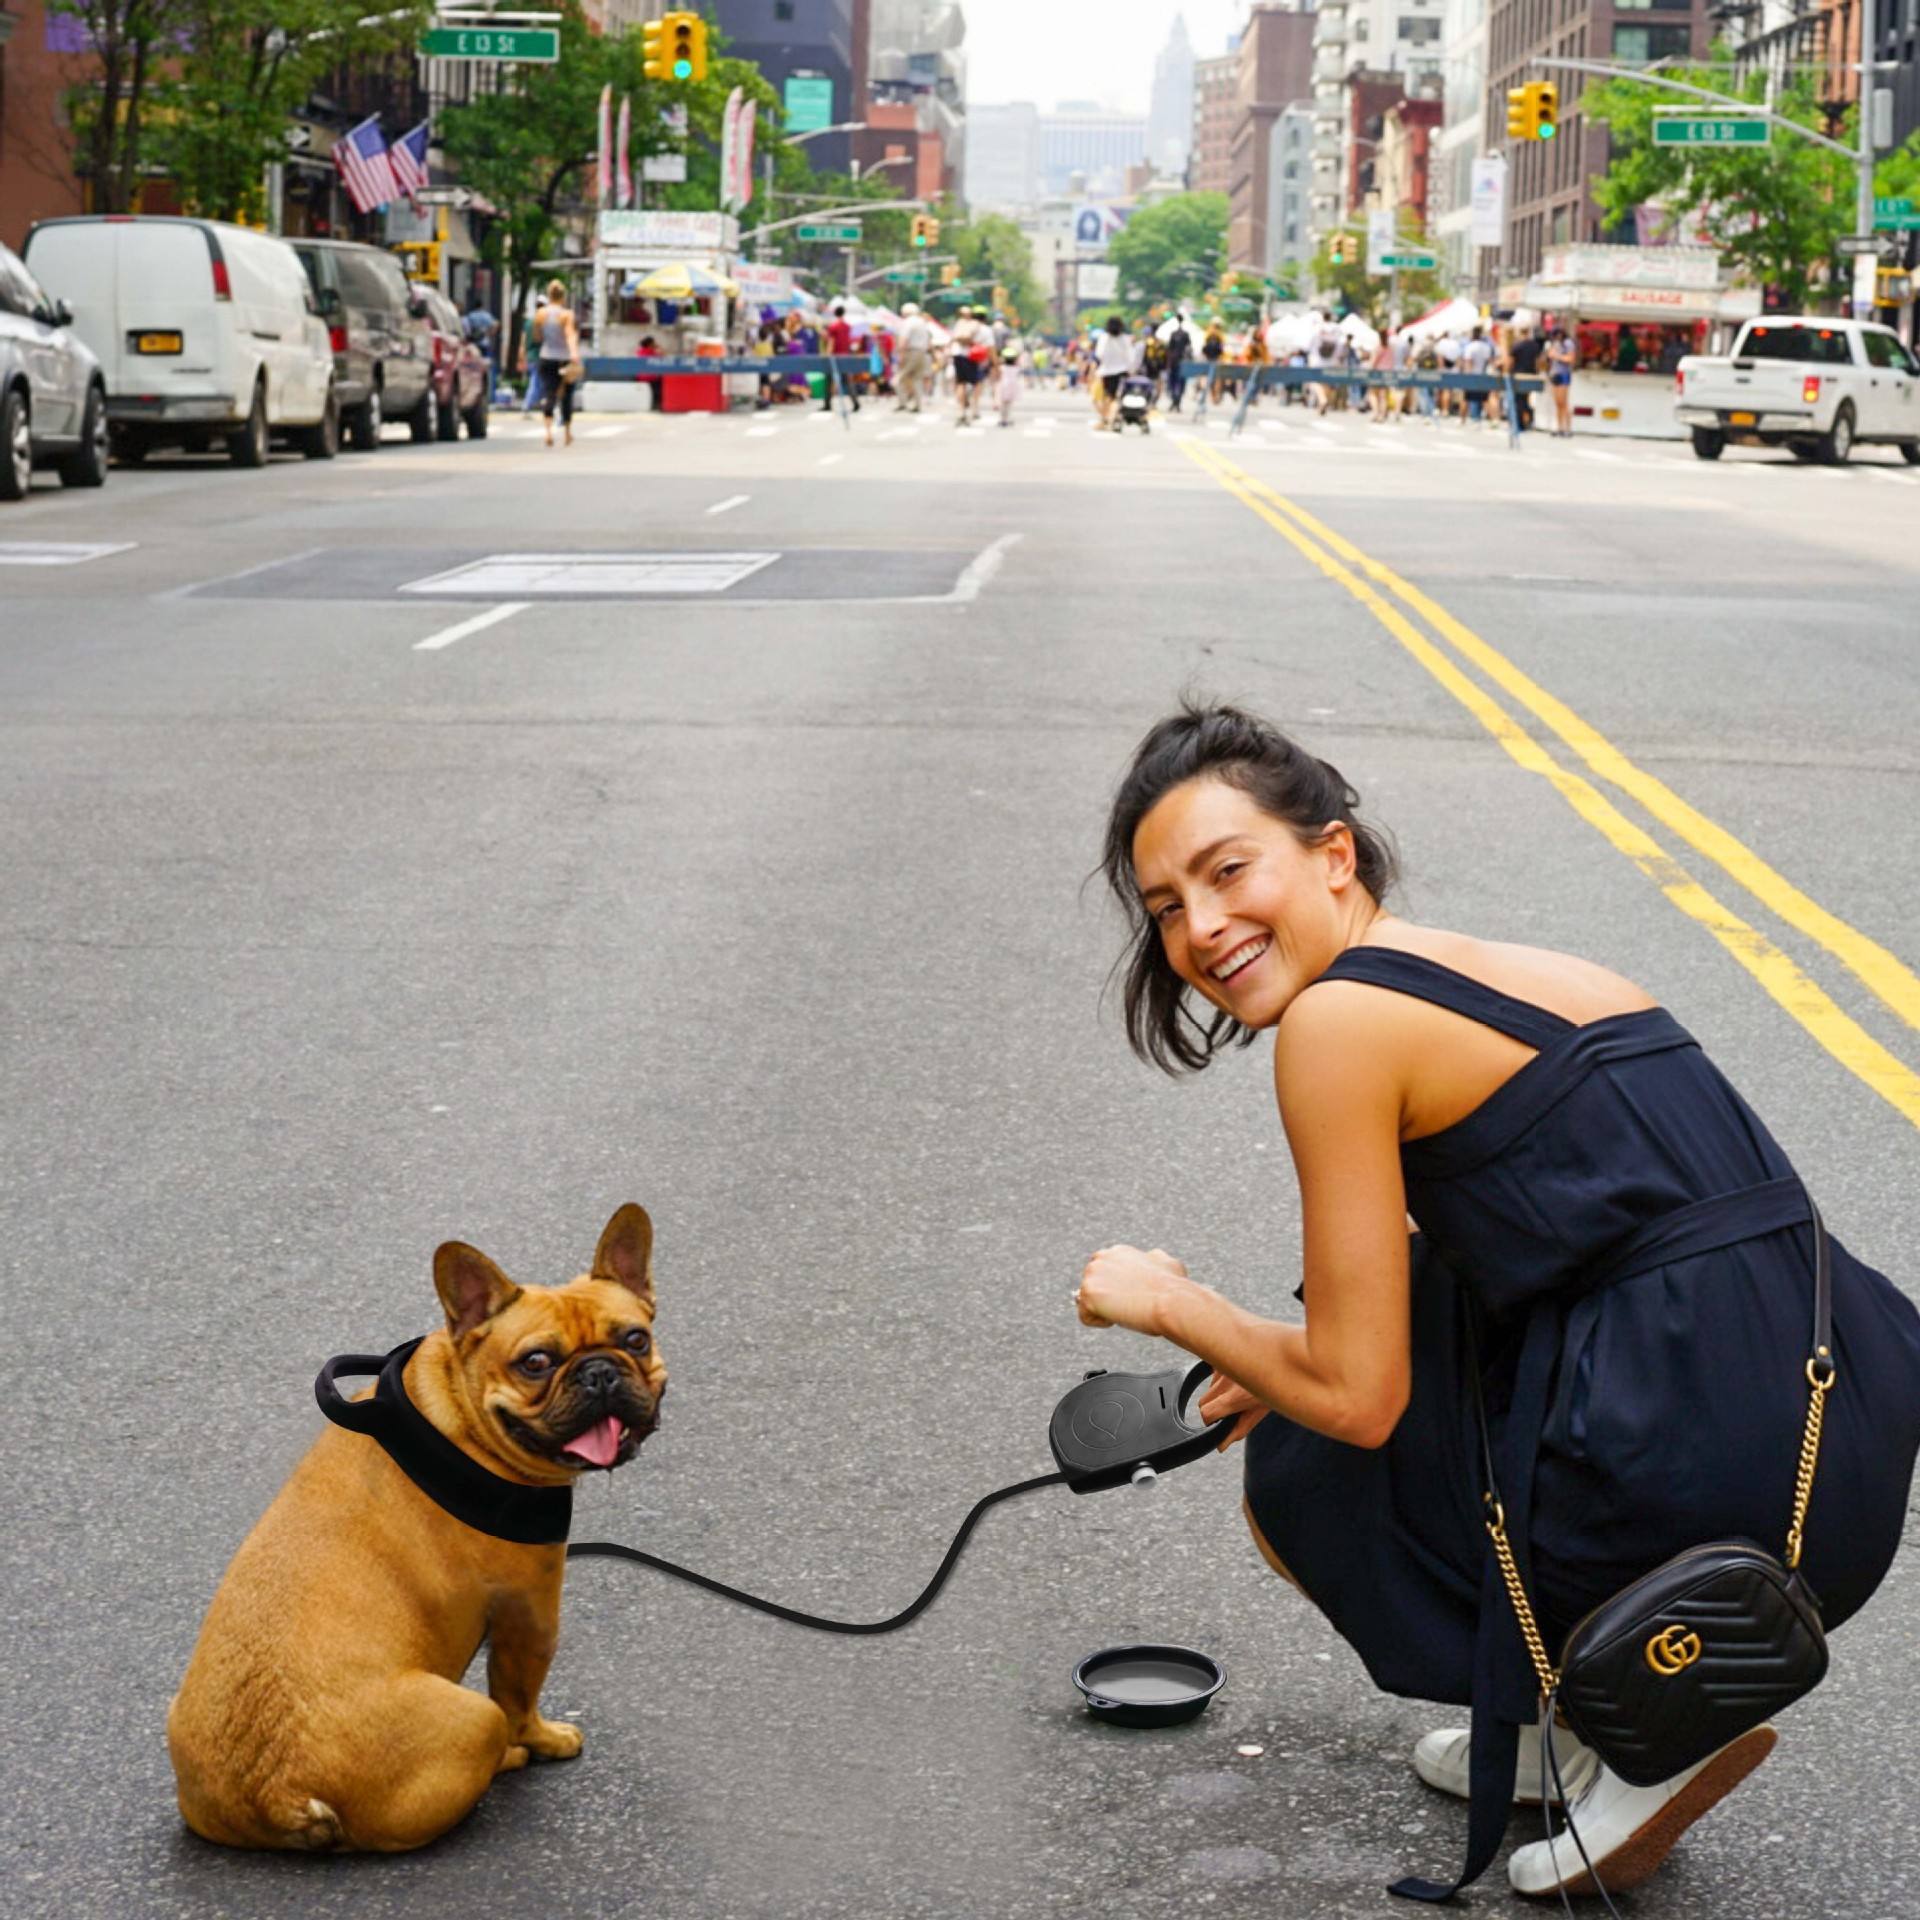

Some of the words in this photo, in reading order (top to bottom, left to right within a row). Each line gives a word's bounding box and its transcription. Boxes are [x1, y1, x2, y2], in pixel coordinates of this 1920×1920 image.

[457, 33, 468, 52] E
[475, 34, 491, 53] 13
[498, 34, 515, 53] St
[1687, 123, 1698, 140] E
[1620, 290, 1683, 305] SAUSAGE
